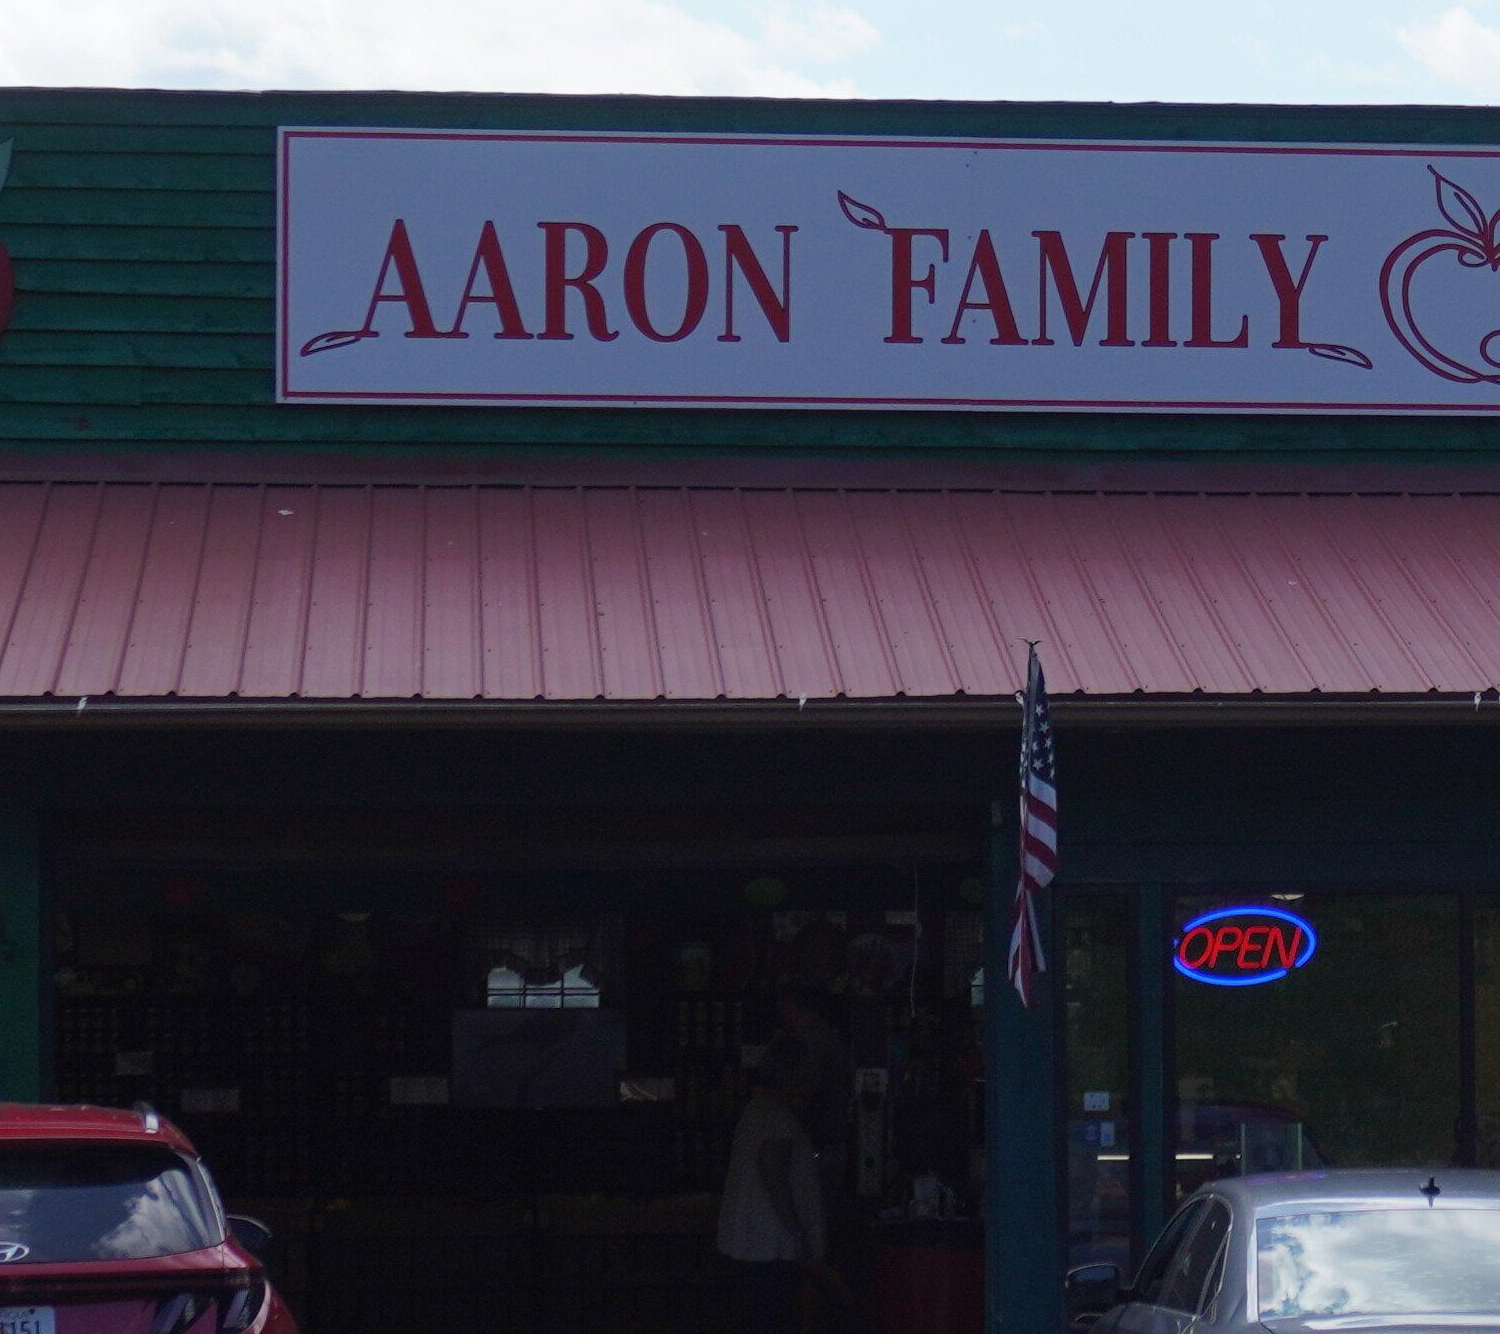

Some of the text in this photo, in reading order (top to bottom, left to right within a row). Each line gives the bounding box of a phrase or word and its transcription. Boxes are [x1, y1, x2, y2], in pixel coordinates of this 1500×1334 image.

[361, 217, 799, 344] AARON
[884, 225, 1329, 349] FAMILY
[1179, 925, 1303, 970] OPEN
